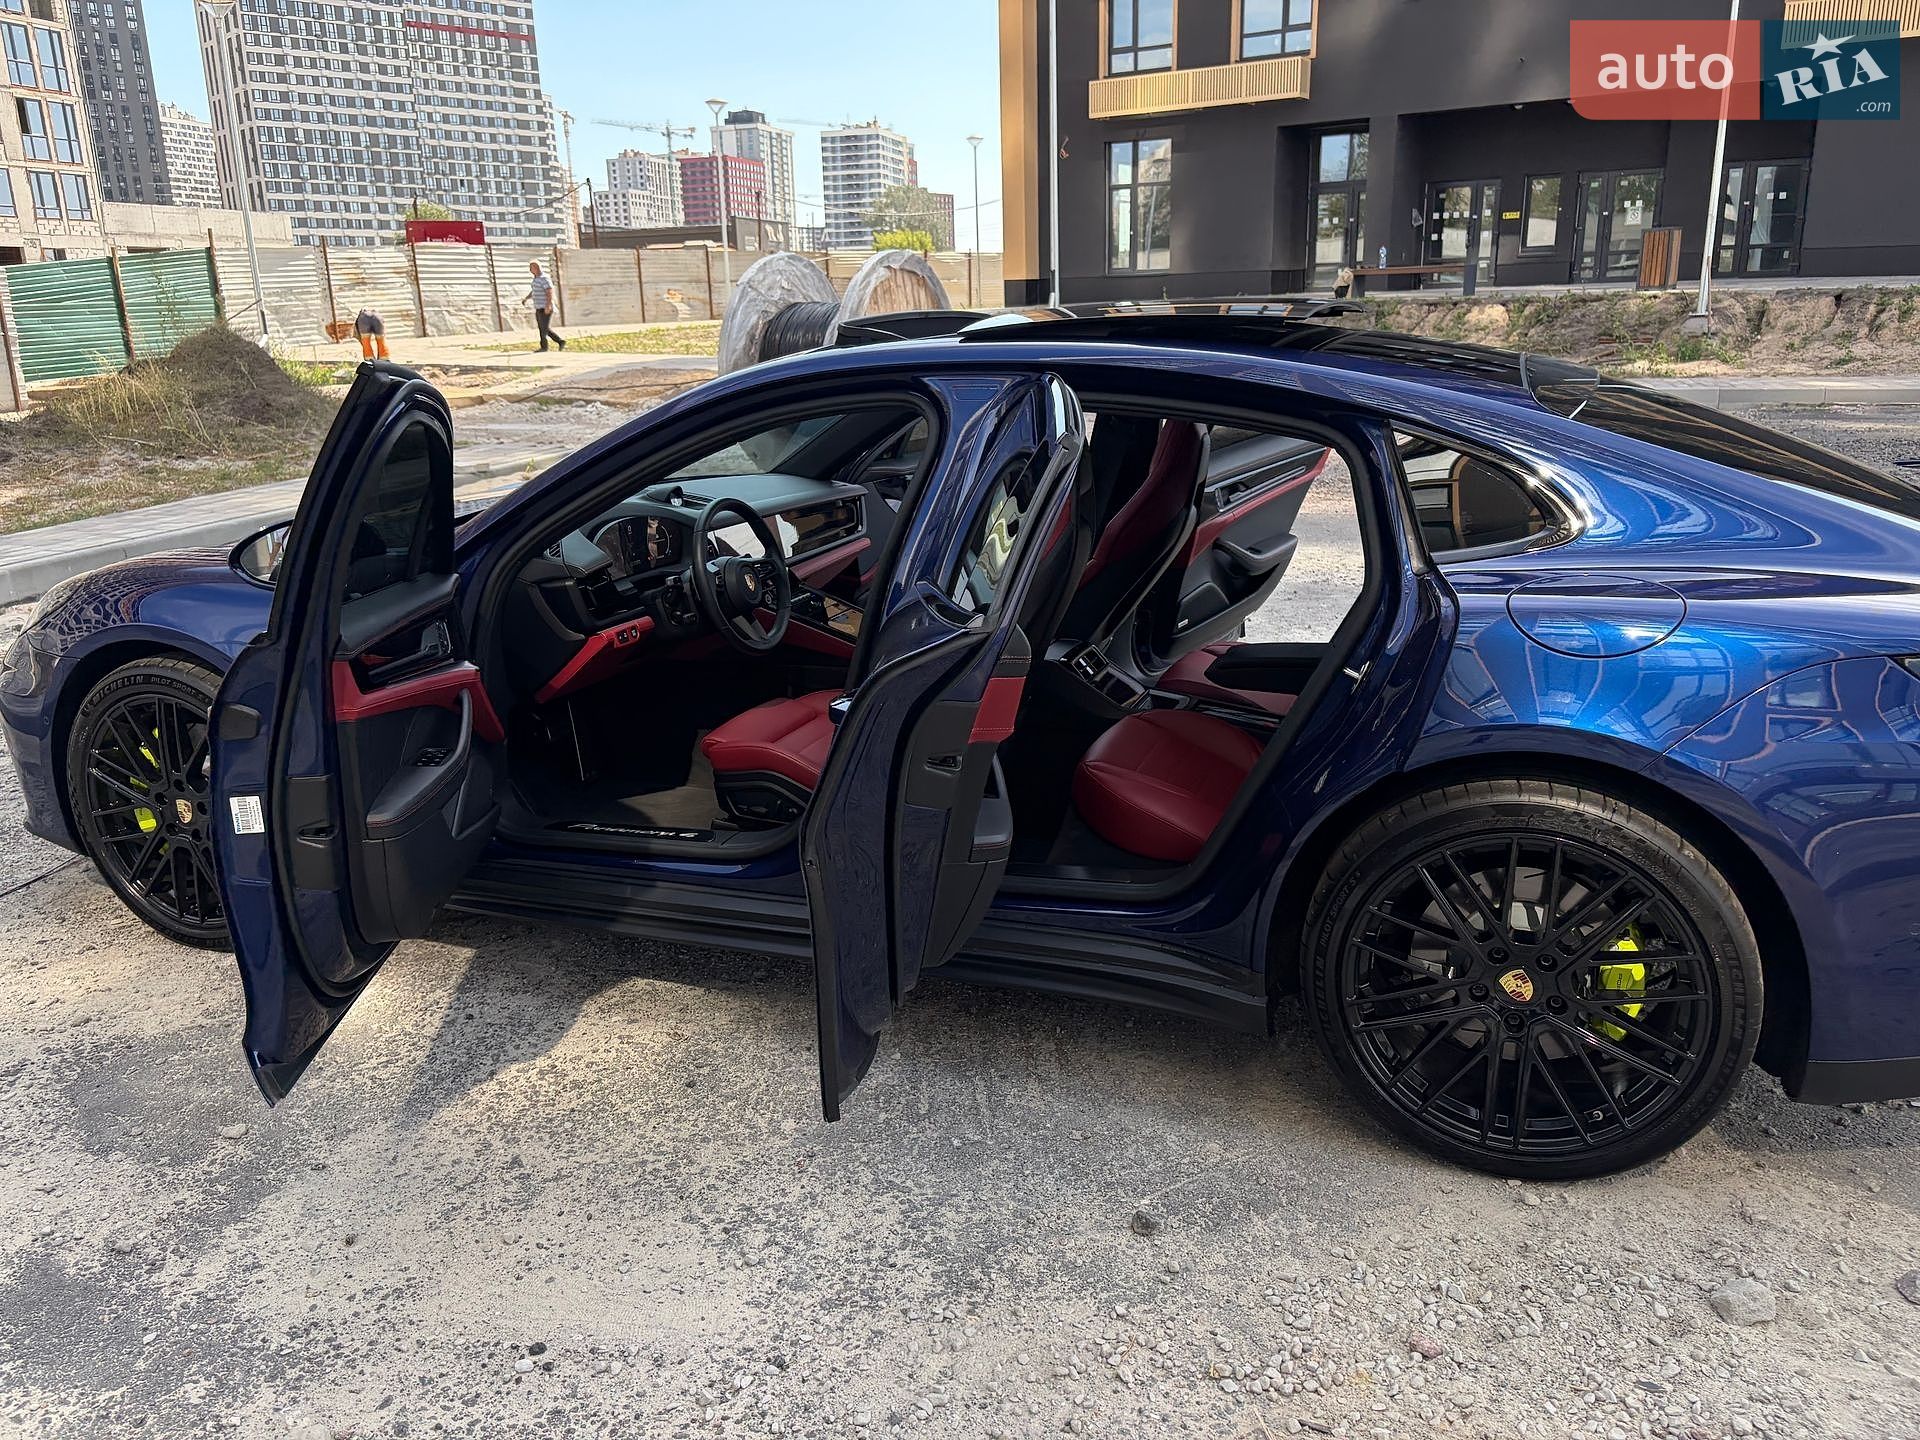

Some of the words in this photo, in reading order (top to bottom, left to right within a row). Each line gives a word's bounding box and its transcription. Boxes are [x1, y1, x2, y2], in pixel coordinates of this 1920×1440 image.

[92, 675, 144, 704] MICHELIN
[151, 676, 172, 686] PILOT
[172, 681, 196, 696] SPORT
